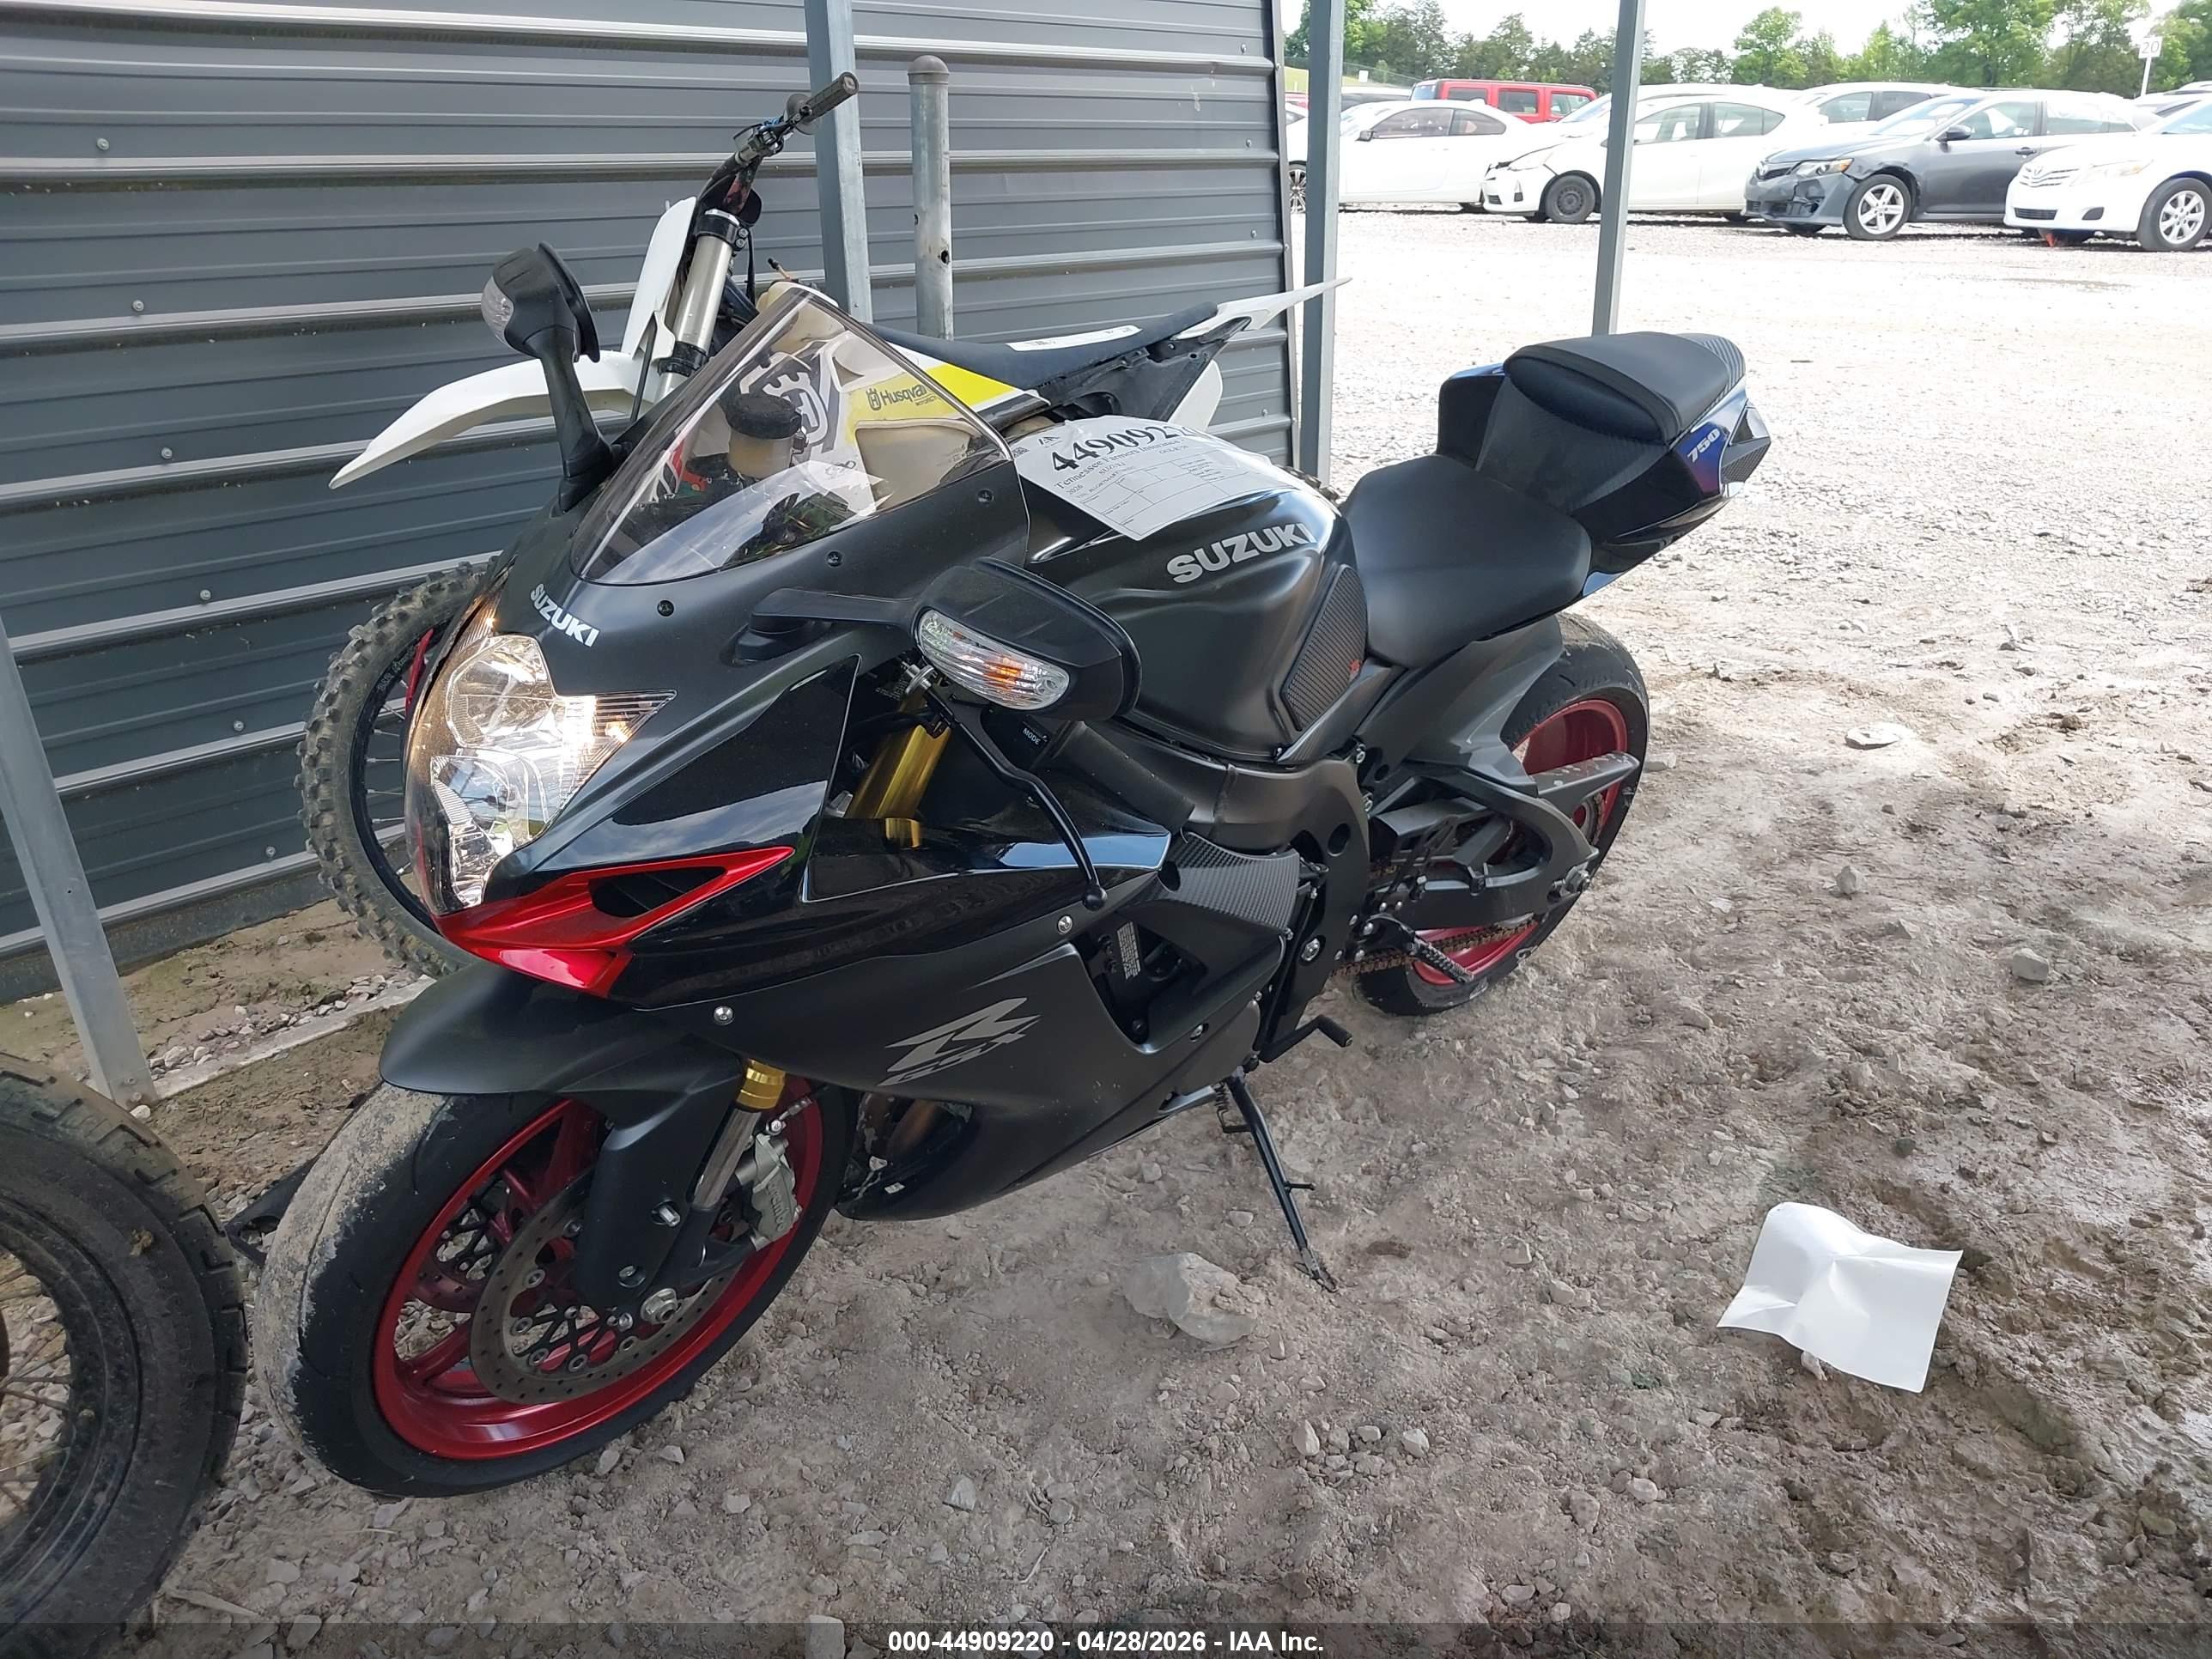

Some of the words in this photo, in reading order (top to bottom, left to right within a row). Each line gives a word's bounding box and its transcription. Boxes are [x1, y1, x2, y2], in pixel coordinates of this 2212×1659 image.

[2142, 41, 2160, 54] 20
[1686, 428, 1721, 463] 750
[1054, 460, 1103, 489] Tennessee
[1166, 522, 1317, 583] SUZUKI
[530, 583, 599, 647] SUZUKI
[1023, 727, 1041, 745] MODE
